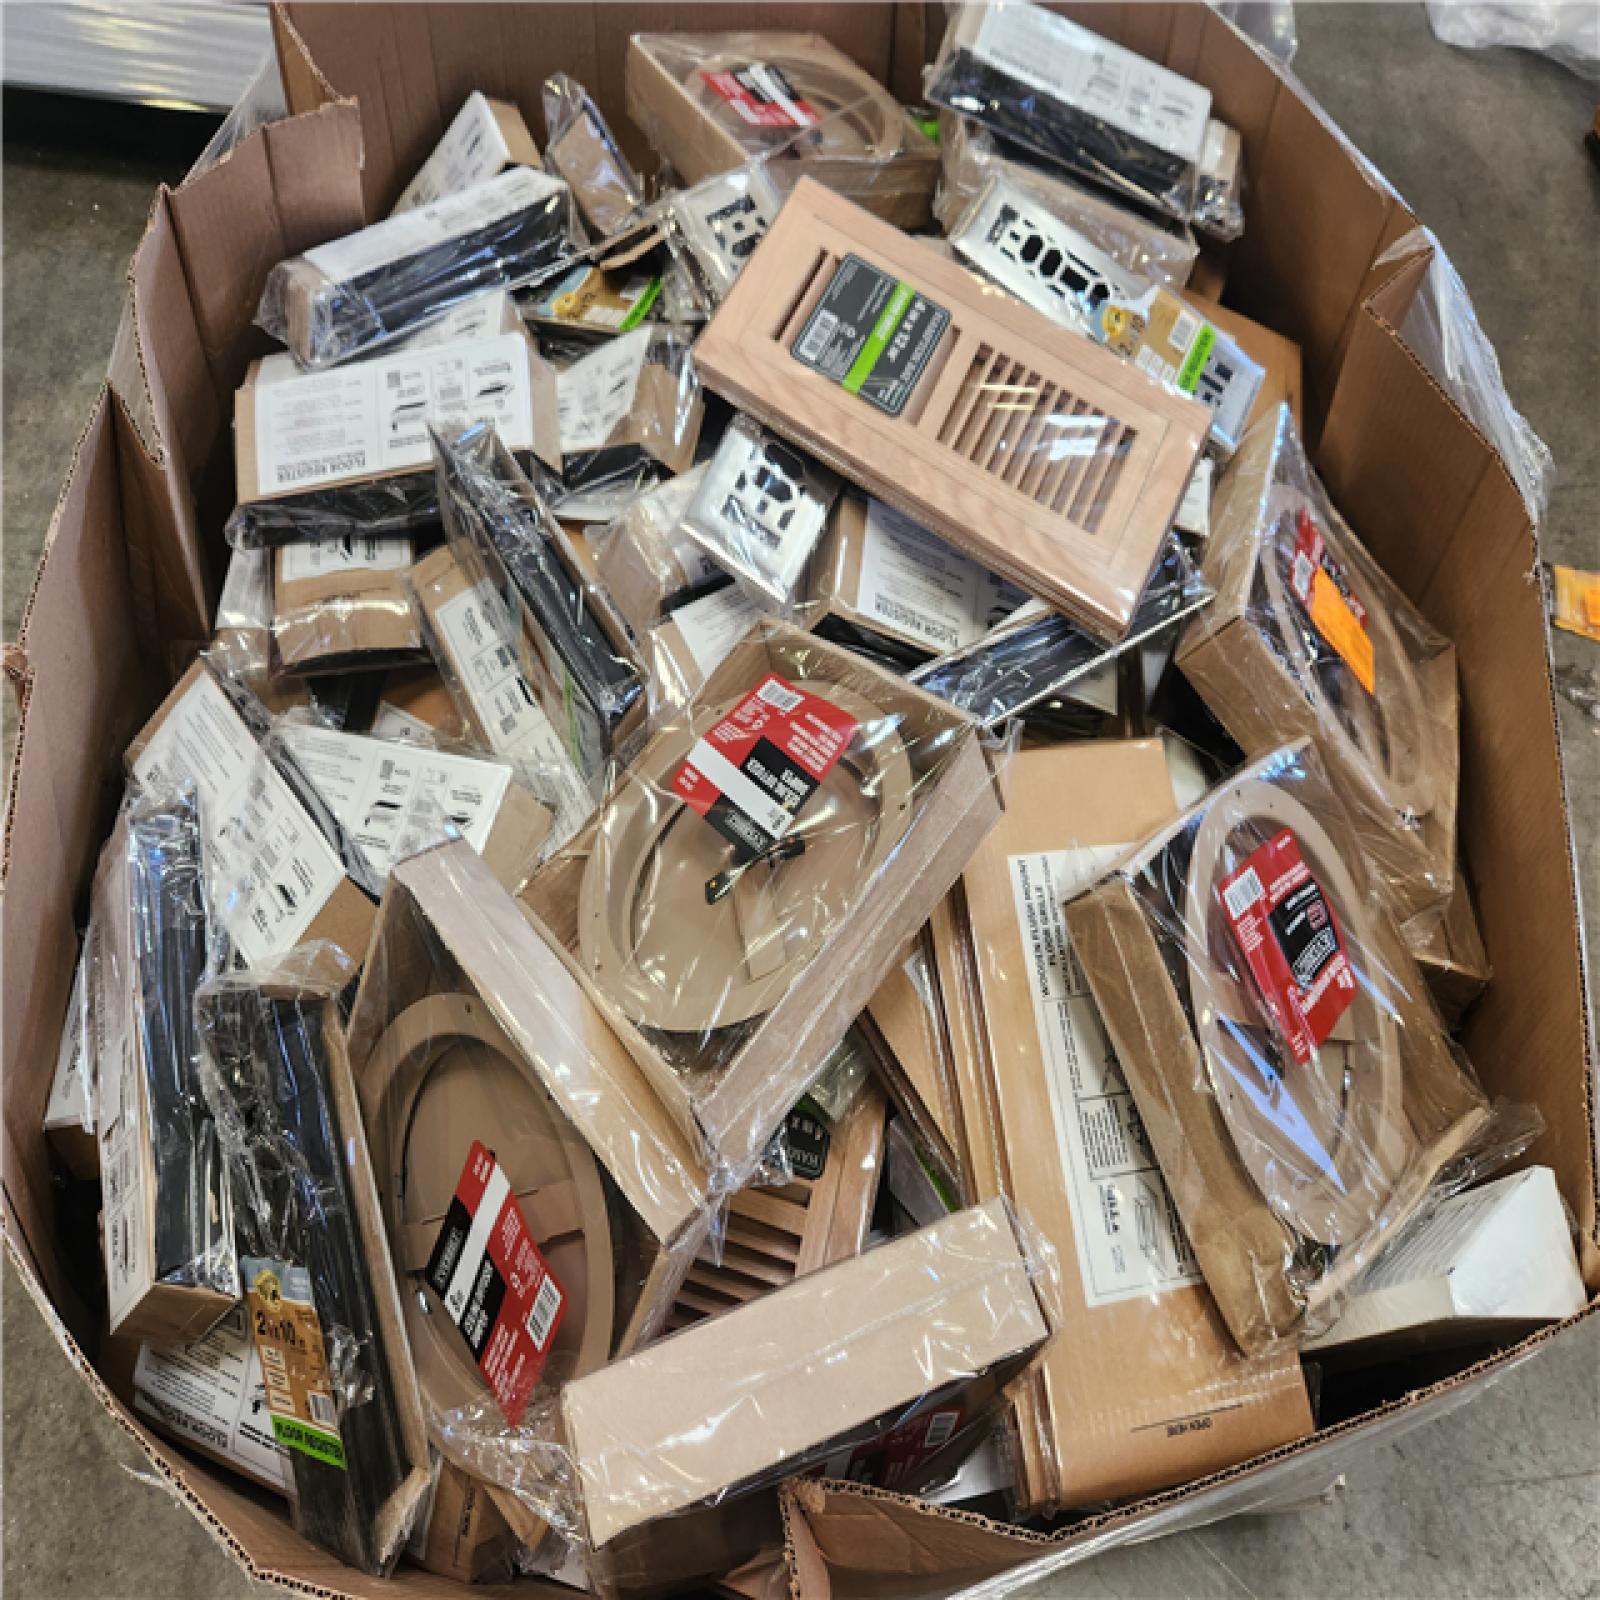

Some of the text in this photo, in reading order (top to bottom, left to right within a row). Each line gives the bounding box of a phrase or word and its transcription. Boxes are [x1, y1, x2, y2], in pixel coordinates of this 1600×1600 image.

[275, 455, 367, 483] FLOOR REGISTER
[1017, 857, 1050, 998] WOODEN FLUSH MOUNT
[1034, 884, 1058, 967] FLOOR GRILLE
[1054, 924, 1073, 994] INSTALLATION
[256, 1311, 266, 1335] 2
[274, 1421, 304, 1442] FLOOR
